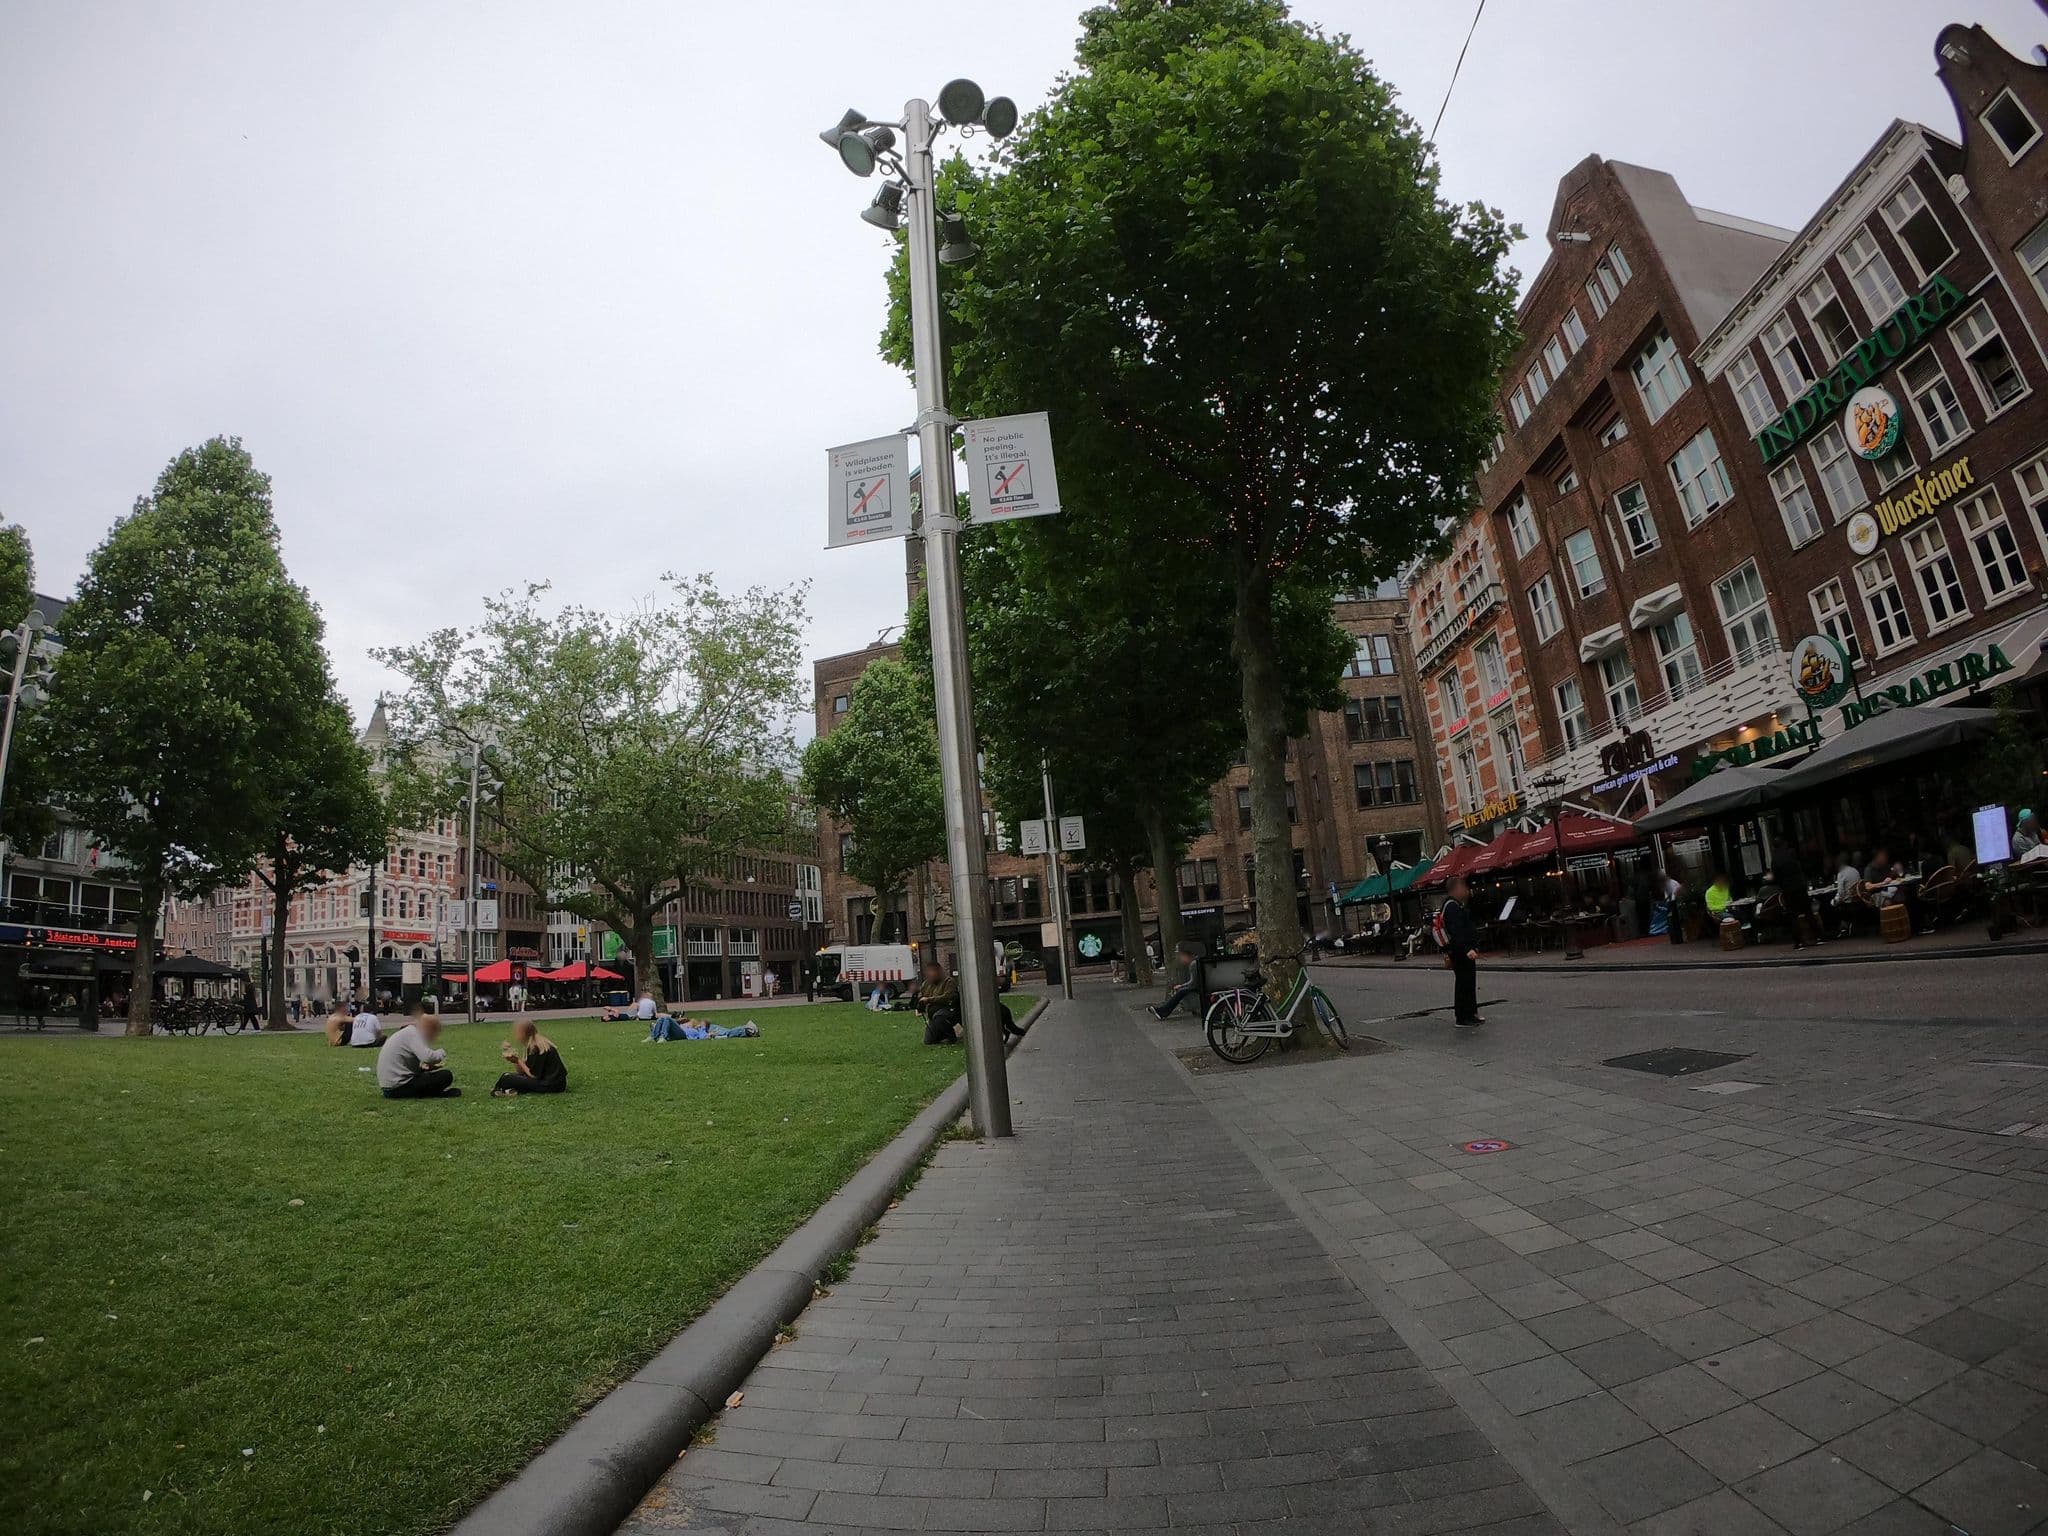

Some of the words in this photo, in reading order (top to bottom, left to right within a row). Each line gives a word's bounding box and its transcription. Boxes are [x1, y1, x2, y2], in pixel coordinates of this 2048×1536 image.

[1754, 272, 1968, 465] INDRAPURA
[983, 435, 995, 443] No
[997, 432, 1025, 443] public
[983, 443, 1017, 453] peeing.
[845, 453, 894, 468] Wildplassen
[1000, 450, 1030, 460] illegal.
[853, 463, 896, 475] verboden.
[1875, 456, 1975, 536] Warsteiner
[1592, 779, 1617, 794] American
[1616, 773, 1629, 788] grill
[1628, 762, 1659, 780] restaurant
[82, 933, 99, 943] Pub
